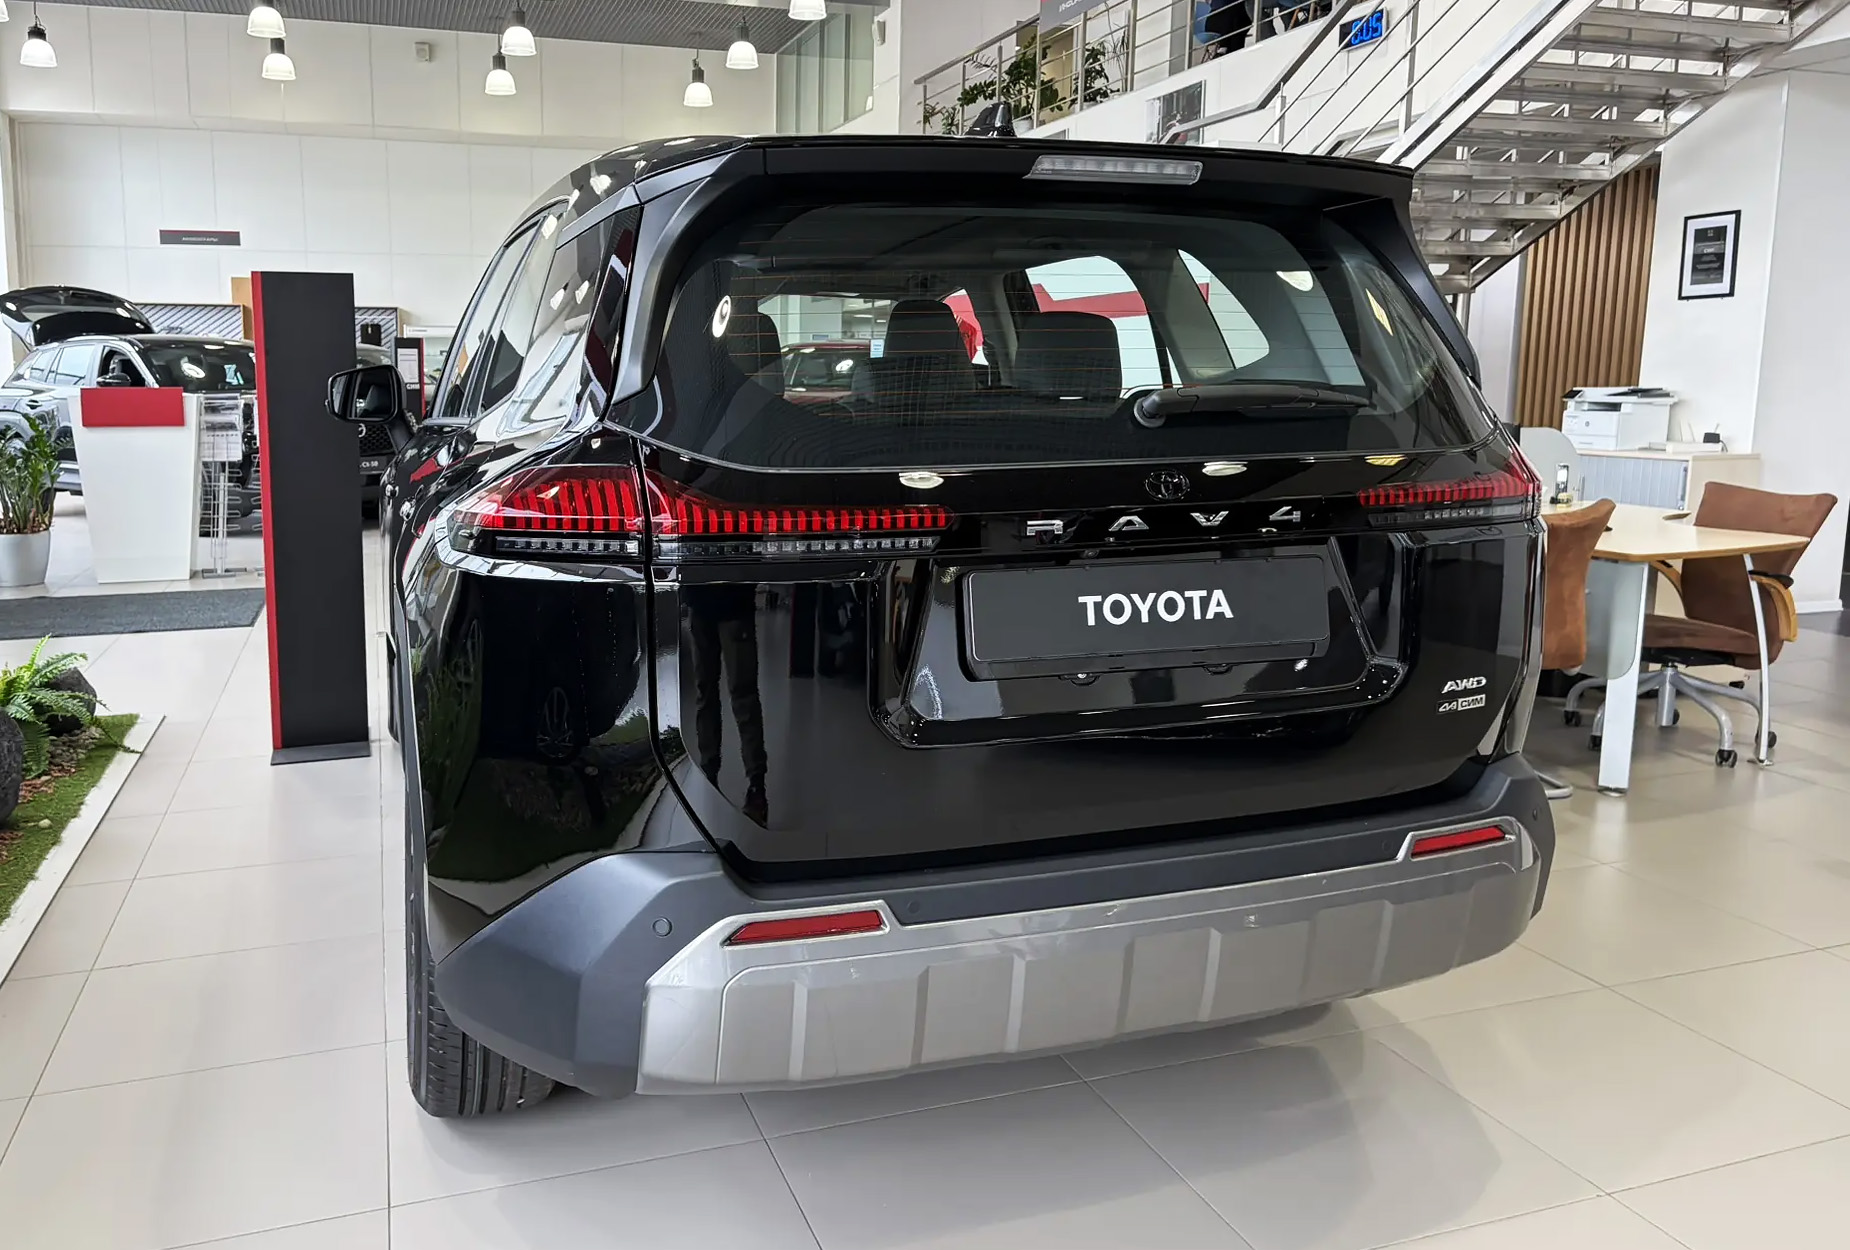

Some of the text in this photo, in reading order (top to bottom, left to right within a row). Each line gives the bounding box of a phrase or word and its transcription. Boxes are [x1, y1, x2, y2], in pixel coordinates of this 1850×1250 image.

[1026, 505, 1301, 536] RAV4
[1078, 589, 1234, 626] TOYOTA
[1441, 676, 1487, 694] AWD
